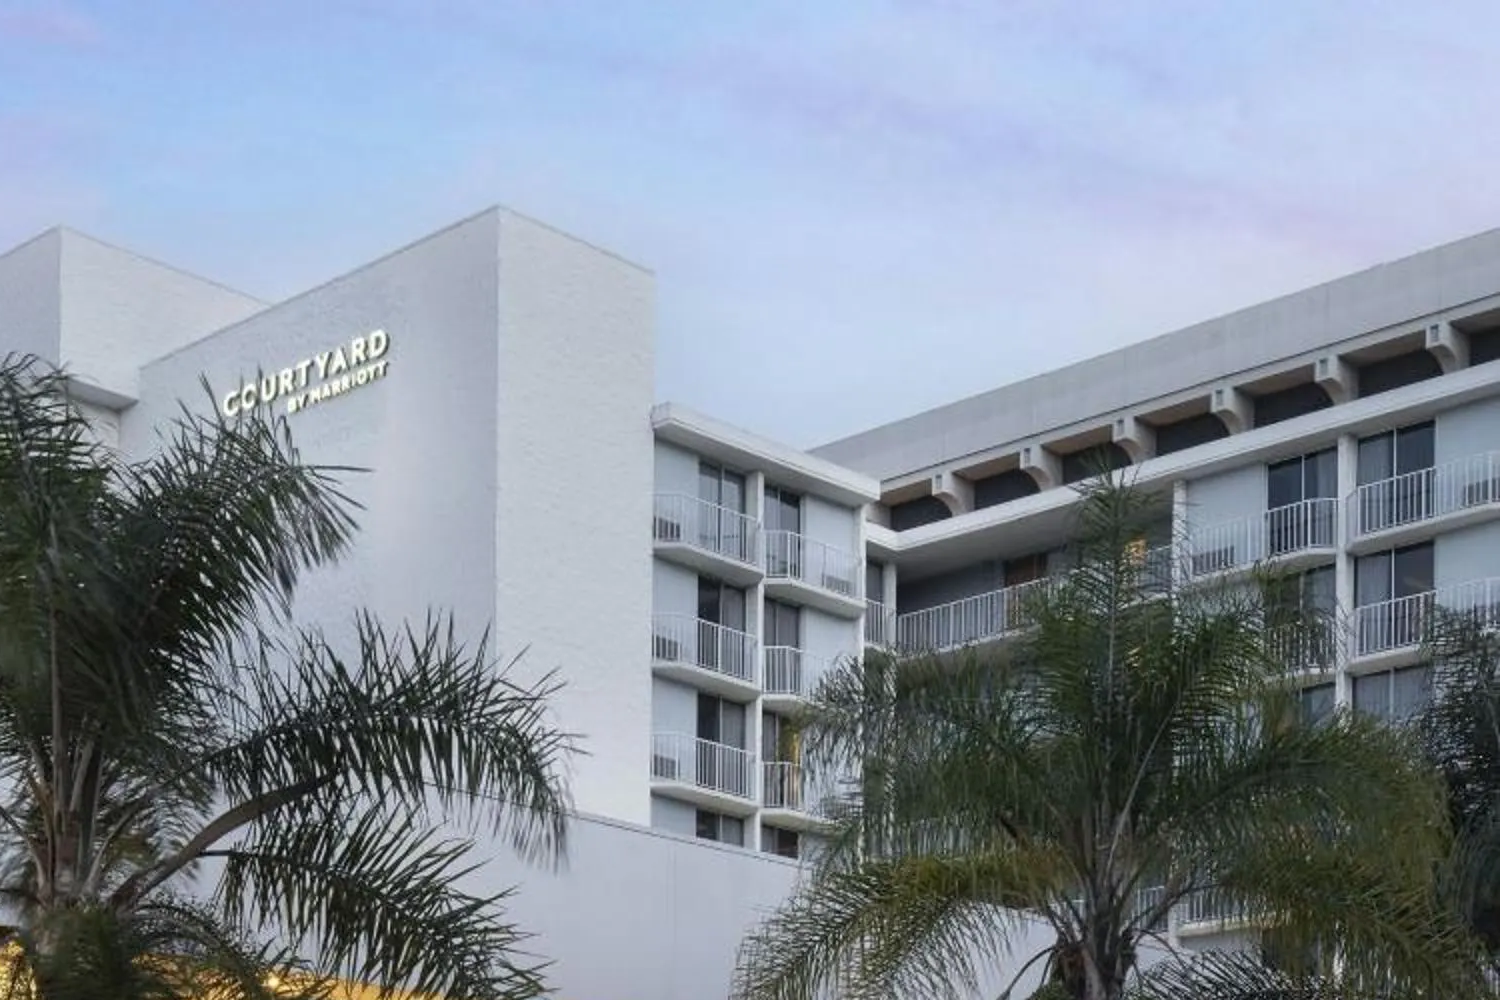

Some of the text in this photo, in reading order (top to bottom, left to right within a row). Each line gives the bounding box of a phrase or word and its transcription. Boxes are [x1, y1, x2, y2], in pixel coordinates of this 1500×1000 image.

[223, 329, 388, 416] COURTYARD
[287, 360, 387, 413] BY MARRIOTT
